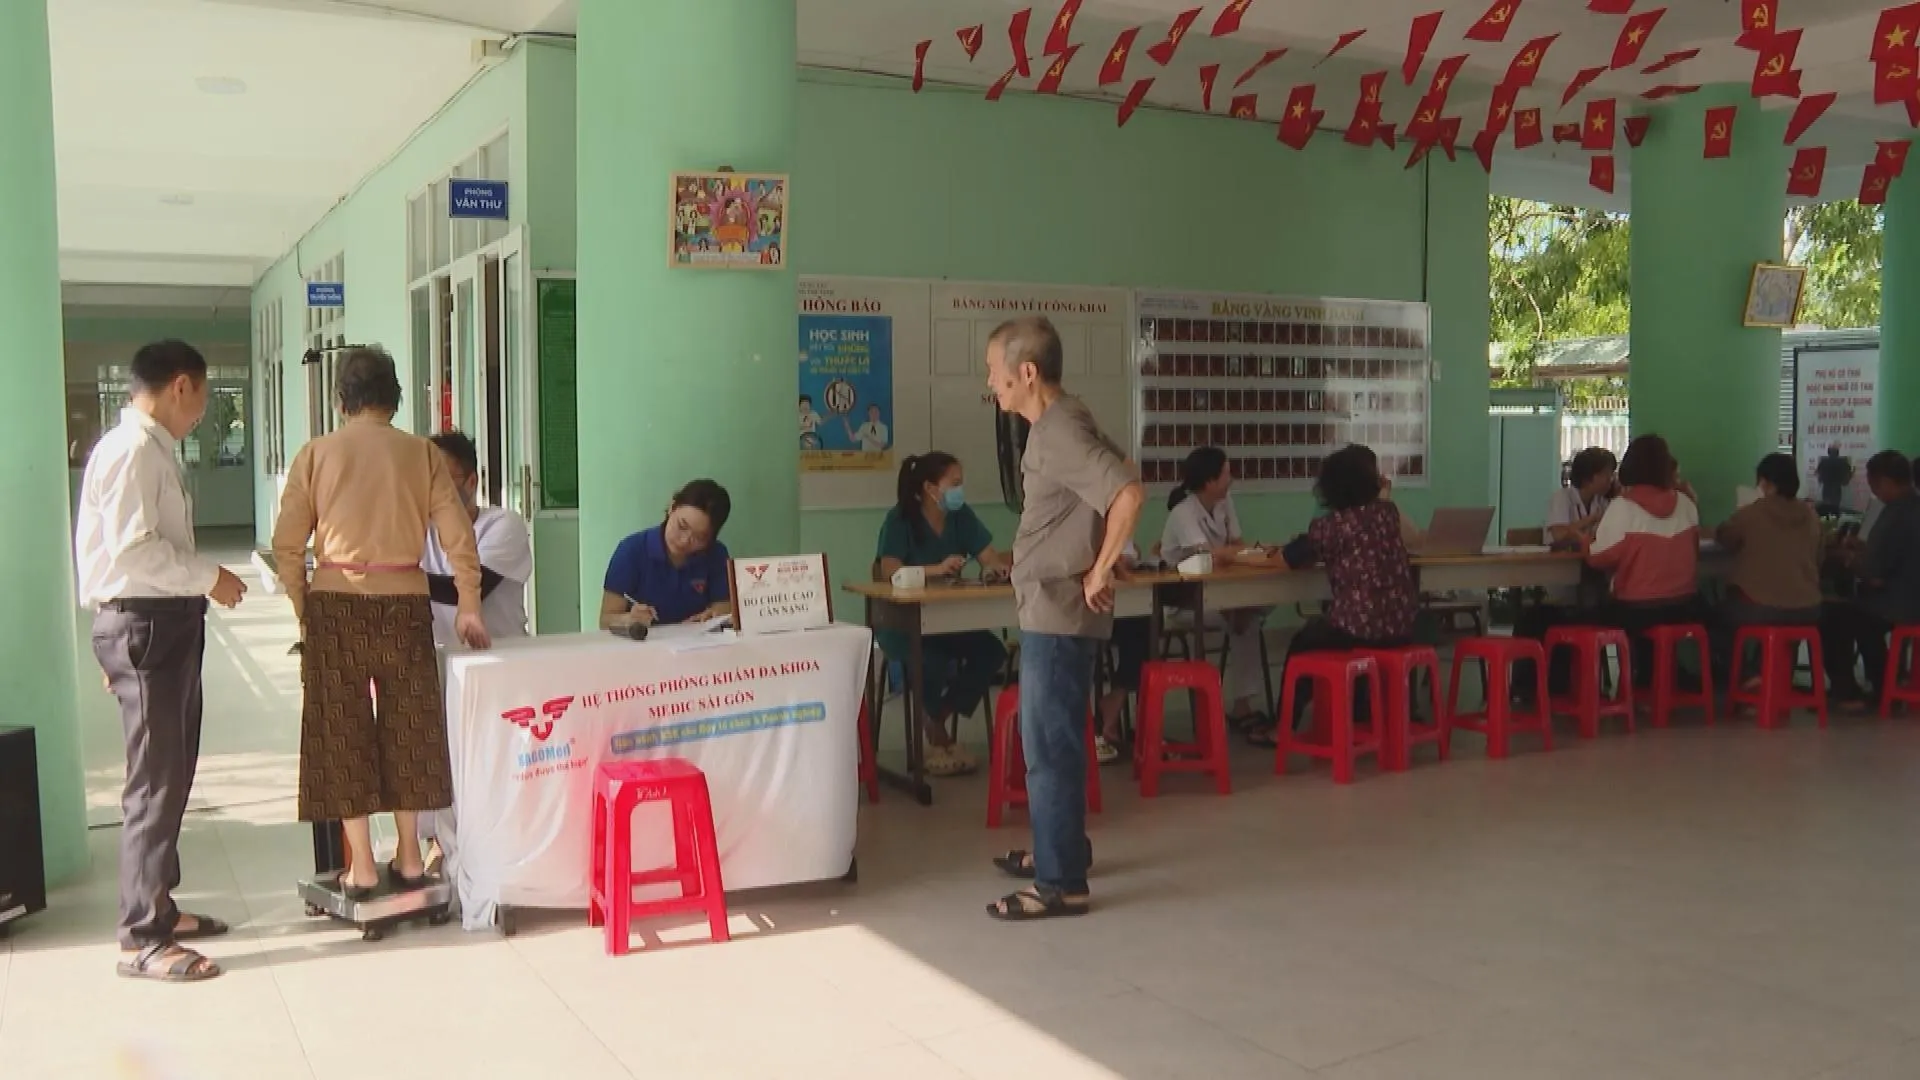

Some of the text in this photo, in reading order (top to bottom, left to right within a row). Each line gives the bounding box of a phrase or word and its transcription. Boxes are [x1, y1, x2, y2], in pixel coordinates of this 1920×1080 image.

[455, 197, 503, 209] VĂN THƯ
[801, 296, 881, 313] HÔNG BÁO
[1254, 302, 1292, 319] VÀNG
[1294, 305, 1326, 320] VINH
[809, 329, 870, 342] HỌC SINH
[792, 590, 814, 601] CAO
[582, 659, 820, 710] HỆ THỐNG PHÒNG KHÁM ĐA KHOA
[648, 688, 755, 719] MEDIC SÀI GÒN
